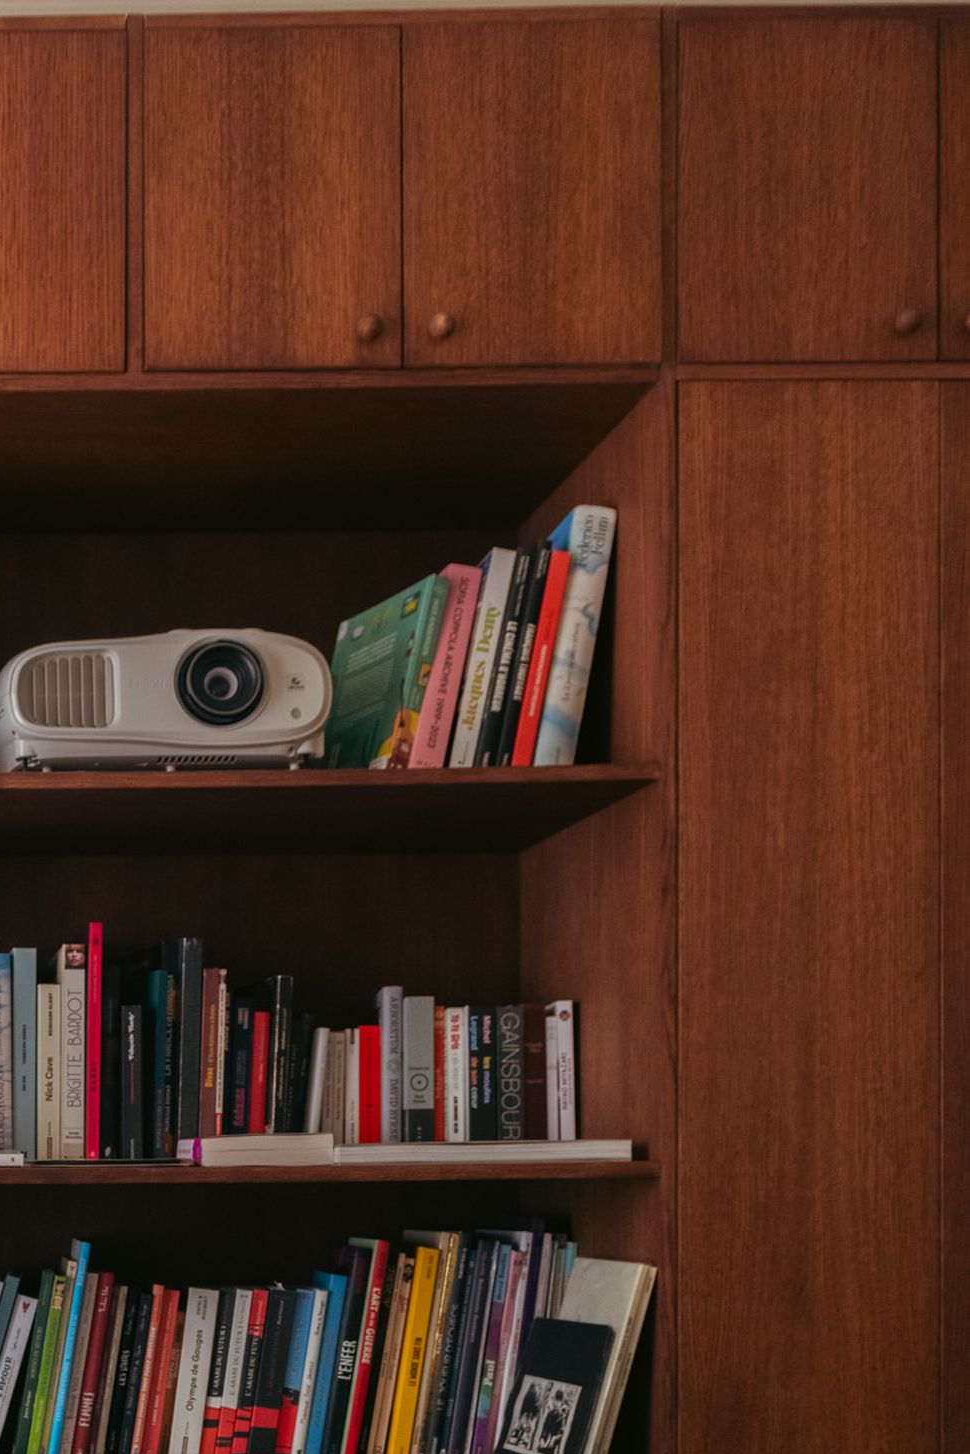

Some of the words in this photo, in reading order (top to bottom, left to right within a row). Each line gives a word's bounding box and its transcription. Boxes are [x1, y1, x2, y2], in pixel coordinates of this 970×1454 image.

[572, 514, 595, 571] Federico
[590, 515, 610, 556] Fellini
[454, 576, 470, 604] SOFIA
[447, 606, 464, 651] COPPOLA
[438, 654, 456, 694] ARCHIVE
[462, 660, 488, 731] Jacques
[482, 606, 502, 654] Demy
[67, 988, 82, 1046] BARDOT
[389, 996, 399, 1054] ARBORETUM
[469, 1015, 479, 1051] Legrand
[482, 1015, 492, 1044] Michel
[44, 1056, 53, 1079] Cave
[470, 1056, 479, 1067] de
[470, 1070, 478, 1086] son
[483, 1056, 492, 1070] les
[500, 1012, 521, 1141] GAINSBOUR
[44, 1081, 53, 1102] Nick
[67, 1054, 82, 1108] BRIGITTE
[389, 1078, 399, 1108] DAVID
[483, 1071, 492, 1104] moulins
[470, 1087, 478, 1109] cœur
[389, 1109, 399, 1141] BYRNE
[370, 1287, 382, 1312] L'ART
[192, 1329, 204, 1362] Gouges
[217, 1329, 227, 1353] FUTUR
[234, 1331, 244, 1355] FUTUR
[361, 1327, 375, 1365] GUERRE
[190, 1363, 199, 1376] de
[337, 1340, 357, 1381] L'ENFER
[485, 1359, 496, 1386] Paul
[79, 1391, 94, 1427] FEMMES
[186, 1377, 199, 1412] Olympe
